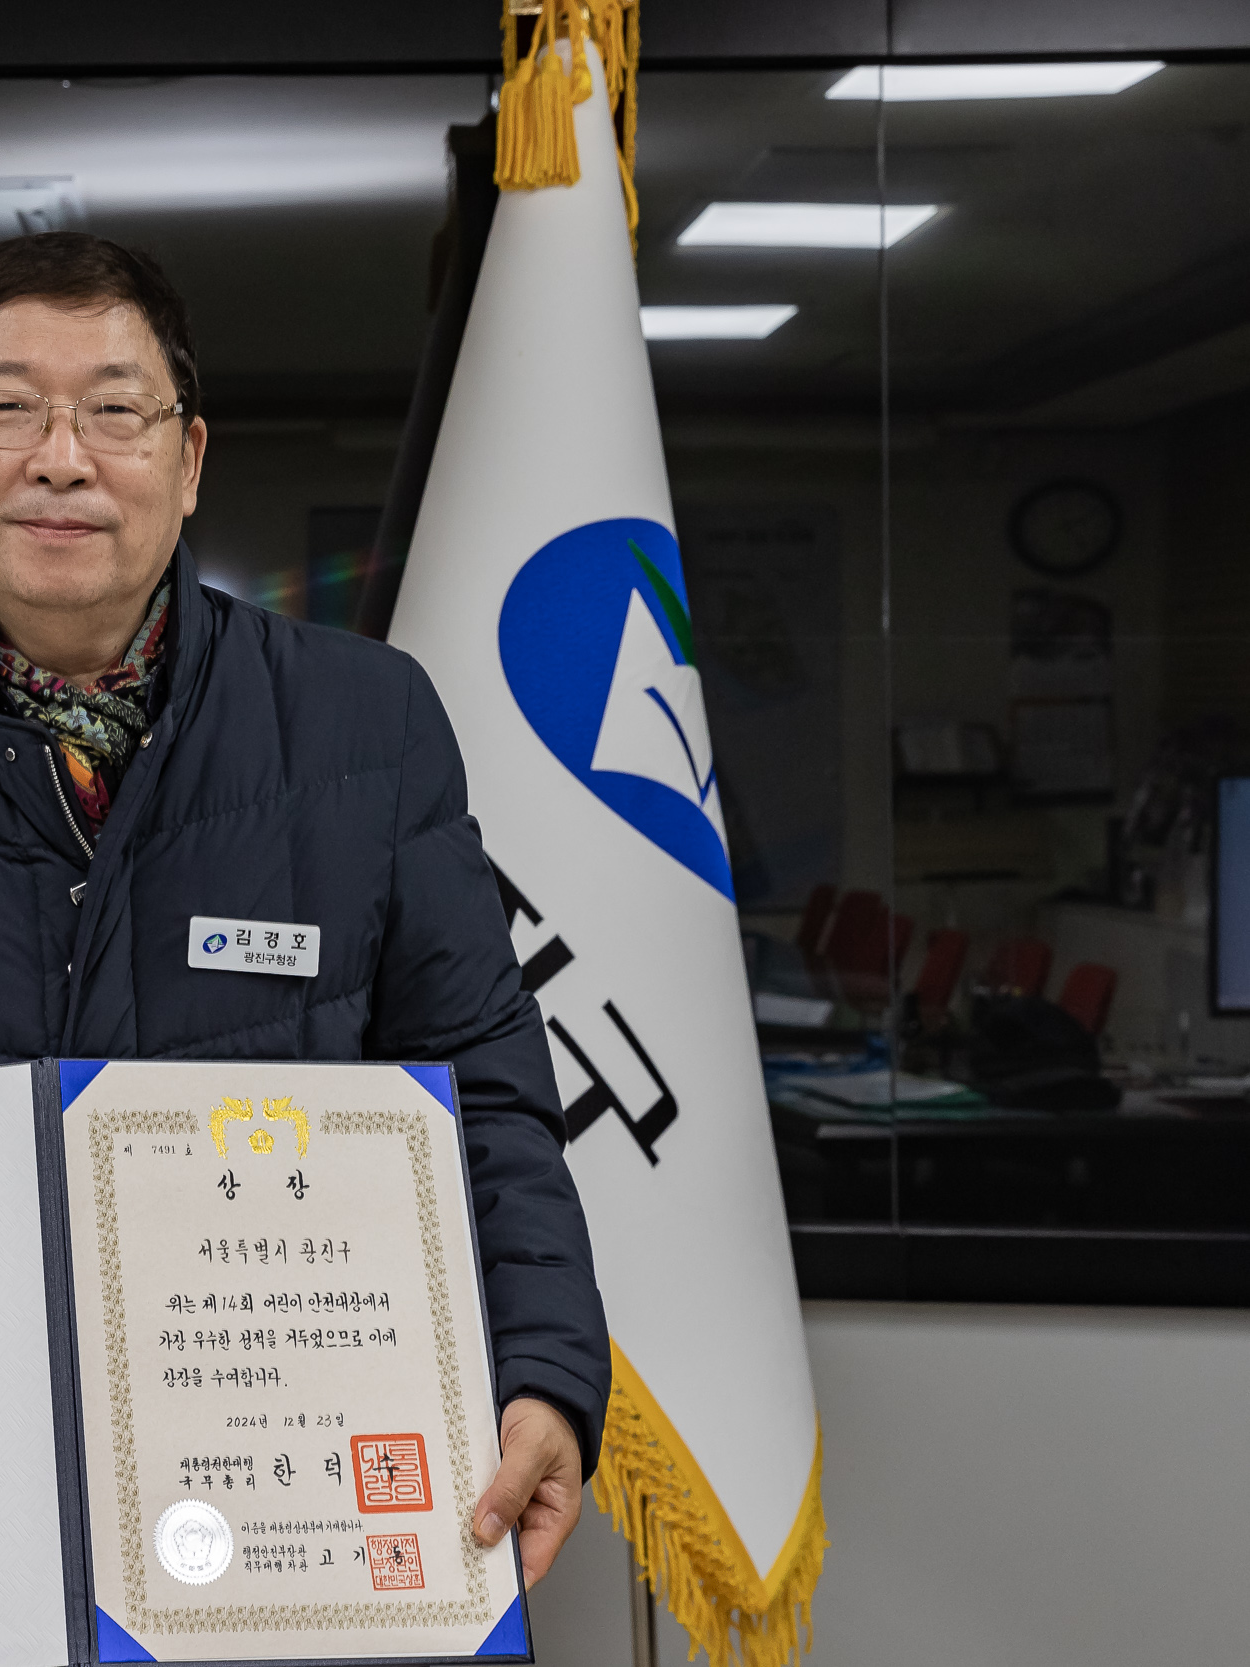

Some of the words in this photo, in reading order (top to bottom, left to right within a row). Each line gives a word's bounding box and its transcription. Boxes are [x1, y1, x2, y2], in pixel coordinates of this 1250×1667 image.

[243, 951, 297, 967] 광진구청장
[151, 1145, 175, 1154] 7491
[185, 1143, 193, 1156] 호
[198, 1238, 287, 1265] 서울특별시
[298, 1238, 351, 1265] 광진구
[164, 1293, 197, 1315] 위는
[263, 1292, 303, 1314] 어린이
[307, 1291, 390, 1314] 안전대상에서
[158, 1329, 187, 1352] 가장
[192, 1329, 231, 1351] 우수한
[238, 1329, 277, 1351] 성적을
[284, 1328, 364, 1350] 거두었으므로
[368, 1327, 397, 1347] 이에
[162, 1367, 203, 1389] 상장을
[210, 1367, 288, 1389] 수여합니다.
[226, 1413, 268, 1429] 2024년
[283, 1413, 306, 1429] 12월
[316, 1412, 344, 1428] 23일
